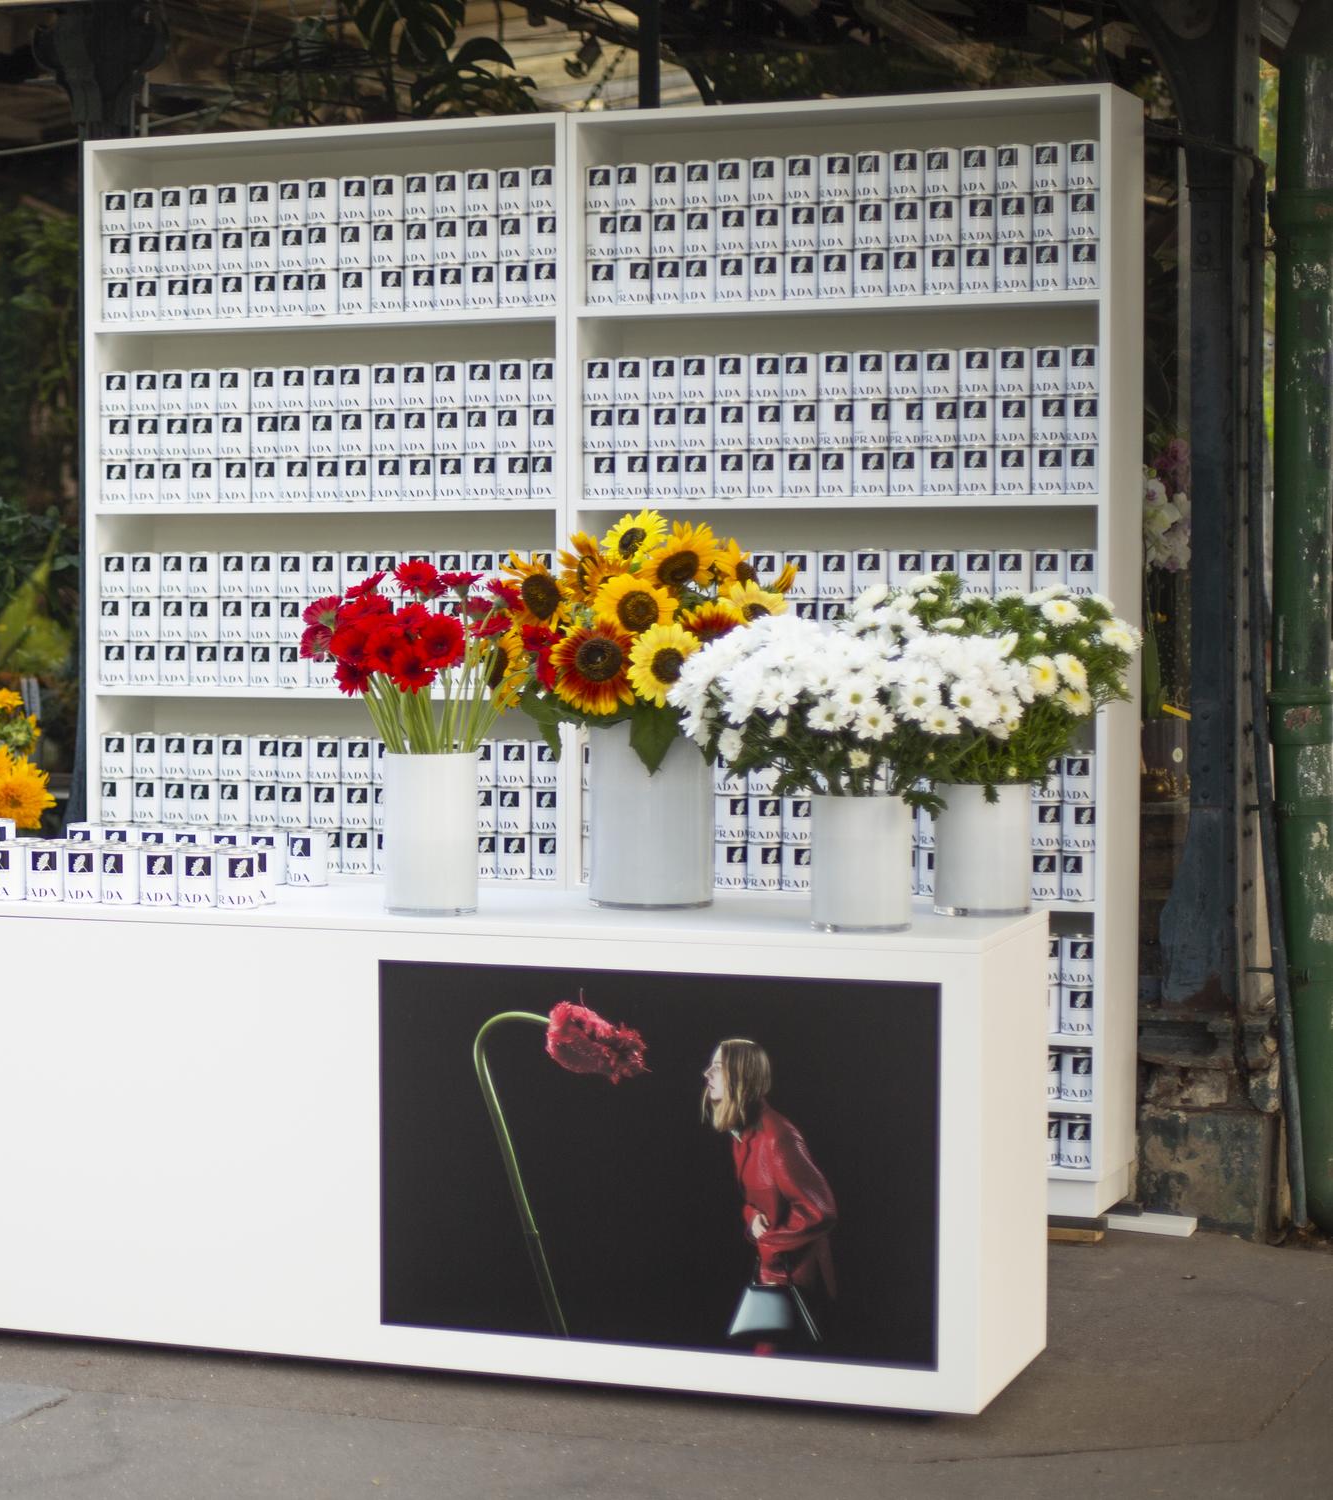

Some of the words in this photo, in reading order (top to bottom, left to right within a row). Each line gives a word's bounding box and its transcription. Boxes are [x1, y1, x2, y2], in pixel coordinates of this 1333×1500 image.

[288, 872, 310, 882] ADA
[68, 889, 93, 899] ADA
[219, 894, 254, 905] RADA
